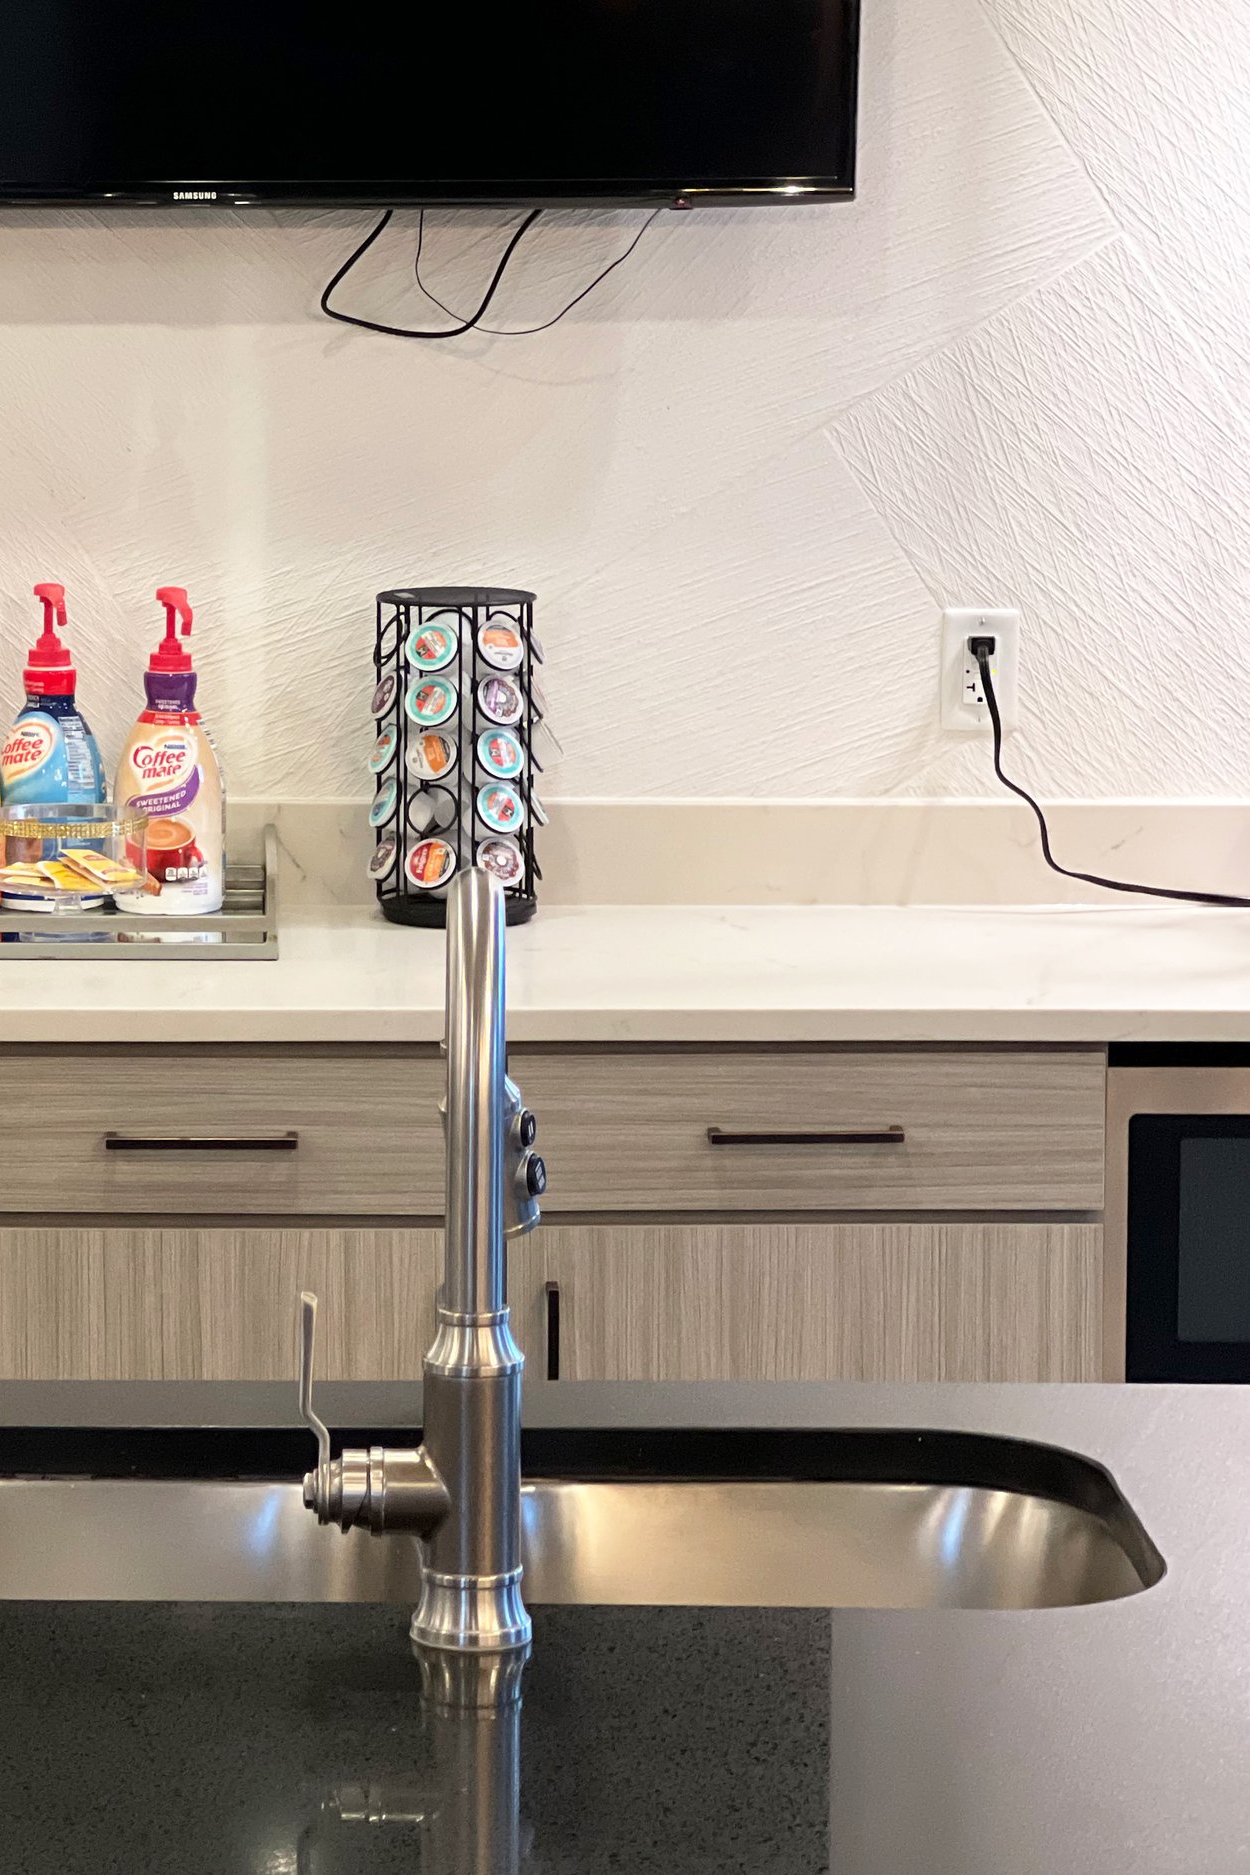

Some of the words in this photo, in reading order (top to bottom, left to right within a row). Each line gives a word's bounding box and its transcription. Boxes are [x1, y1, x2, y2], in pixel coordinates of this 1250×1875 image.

[173, 192, 217, 200] SAMSUNG
[1, 738, 44, 755] offee
[1, 750, 42, 767] mate
[133, 745, 186, 768] Coffee
[142, 764, 182, 779] mate
[136, 790, 187, 808] SWEETENED
